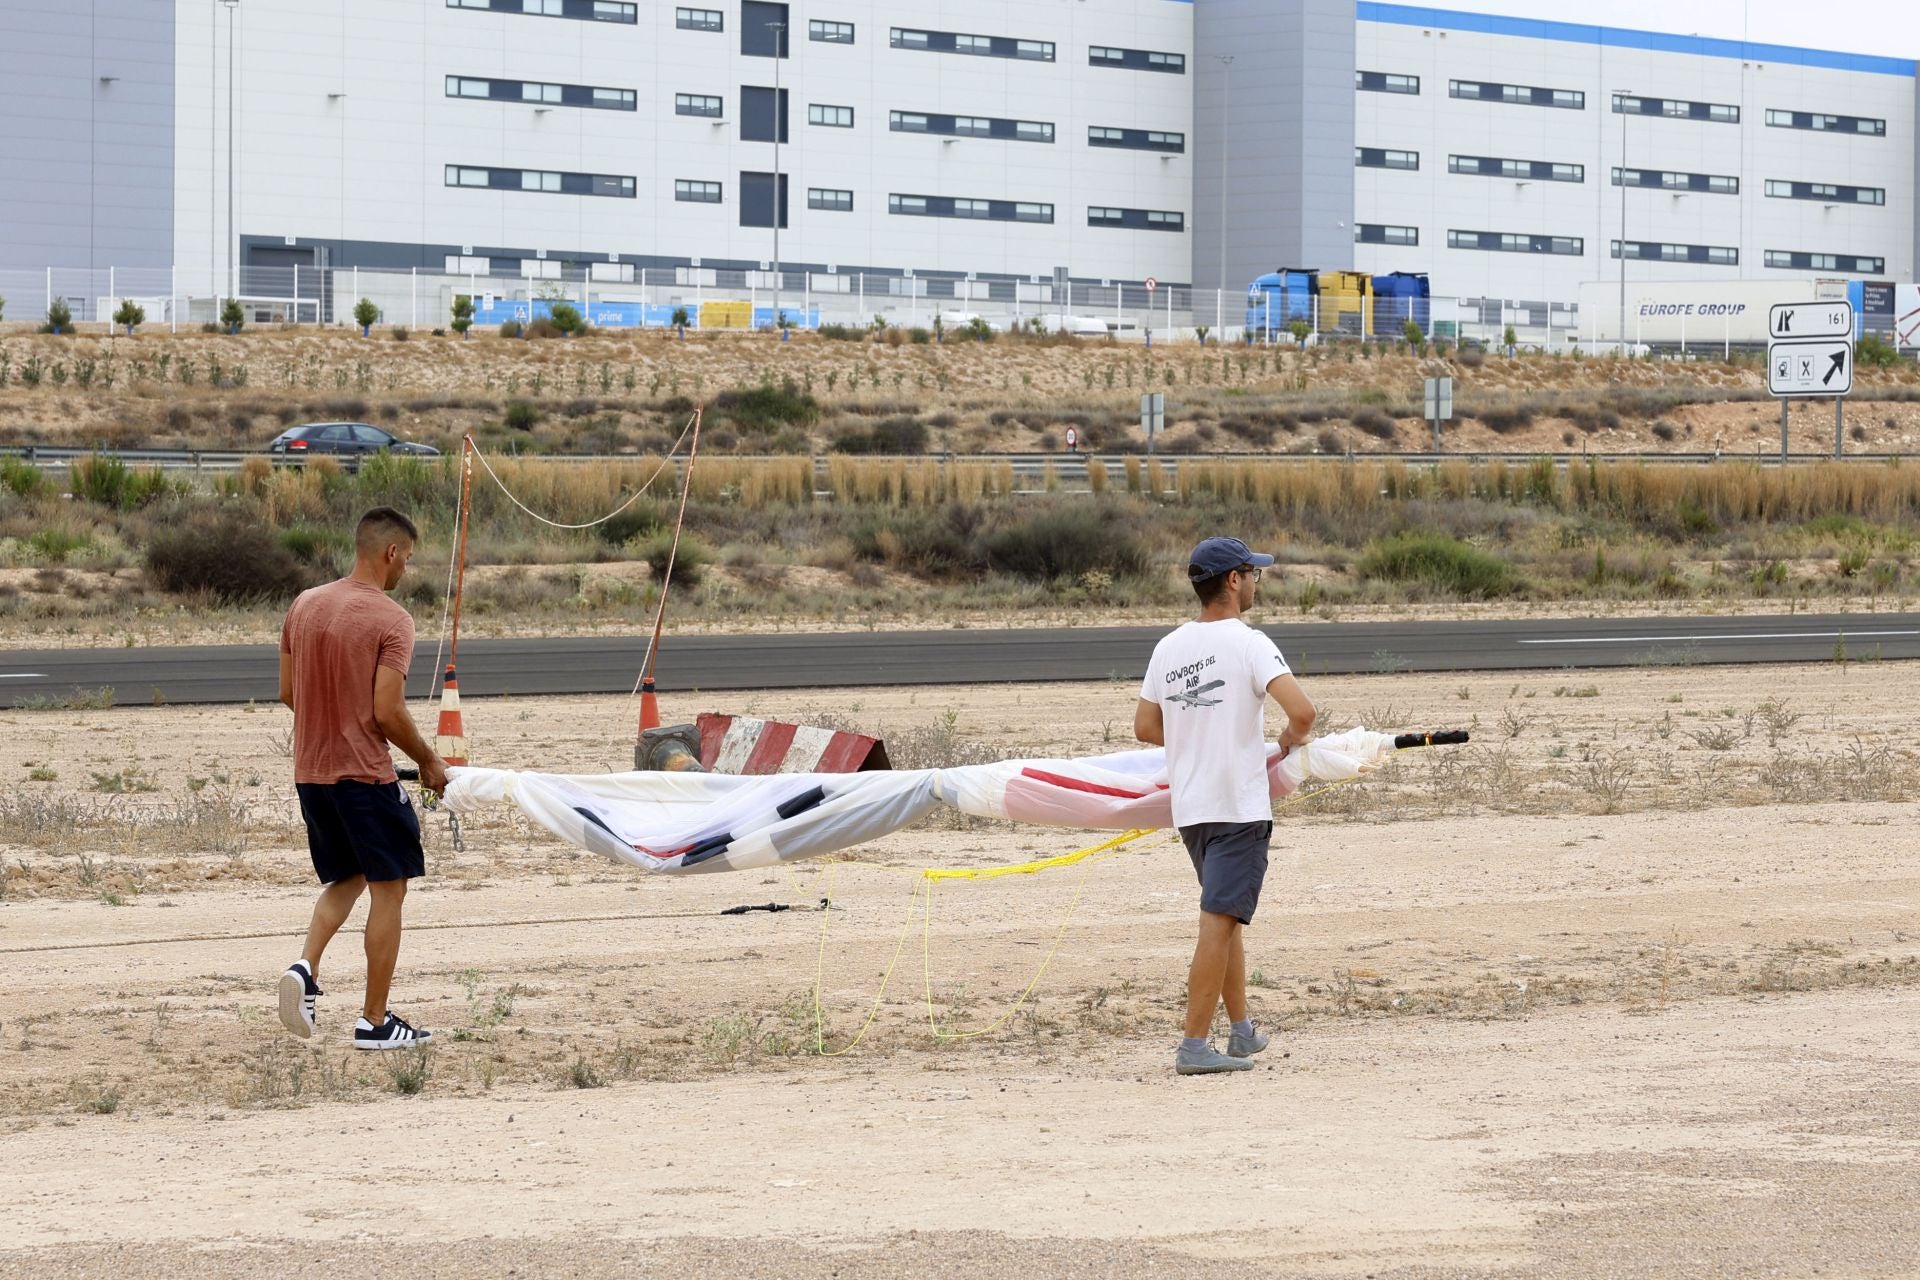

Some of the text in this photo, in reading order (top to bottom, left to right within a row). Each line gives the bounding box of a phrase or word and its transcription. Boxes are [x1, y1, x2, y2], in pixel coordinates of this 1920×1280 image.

[598, 309, 623, 324] prime
[1639, 304, 1745, 316] EUROPE GROUP
[1828, 313, 1844, 325] 161
[1165, 655, 1216, 684] COWBOYS DEL
[1185, 674, 1200, 690] AIR
